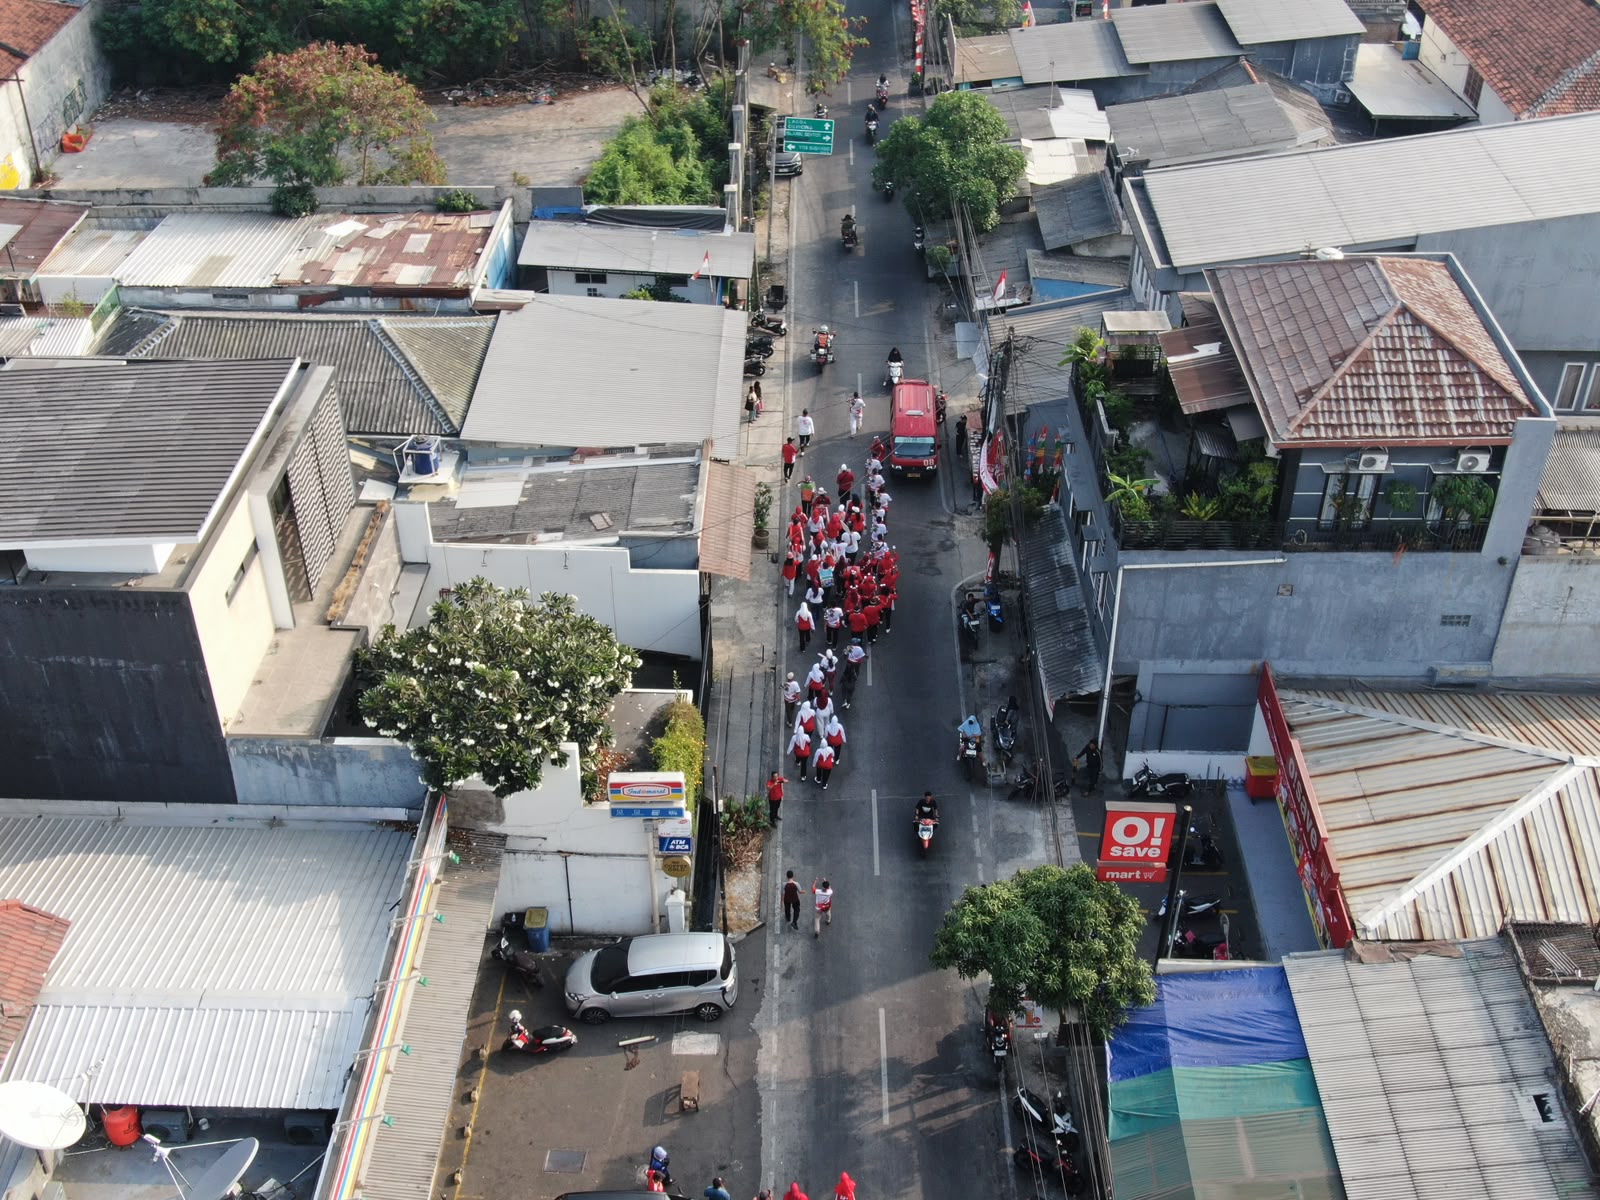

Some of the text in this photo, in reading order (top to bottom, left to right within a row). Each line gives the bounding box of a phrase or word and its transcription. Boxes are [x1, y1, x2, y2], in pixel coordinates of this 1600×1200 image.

[1111, 816, 1166, 846] O!
[1109, 846, 1161, 858] save
[1105, 870, 1142, 879] mart
